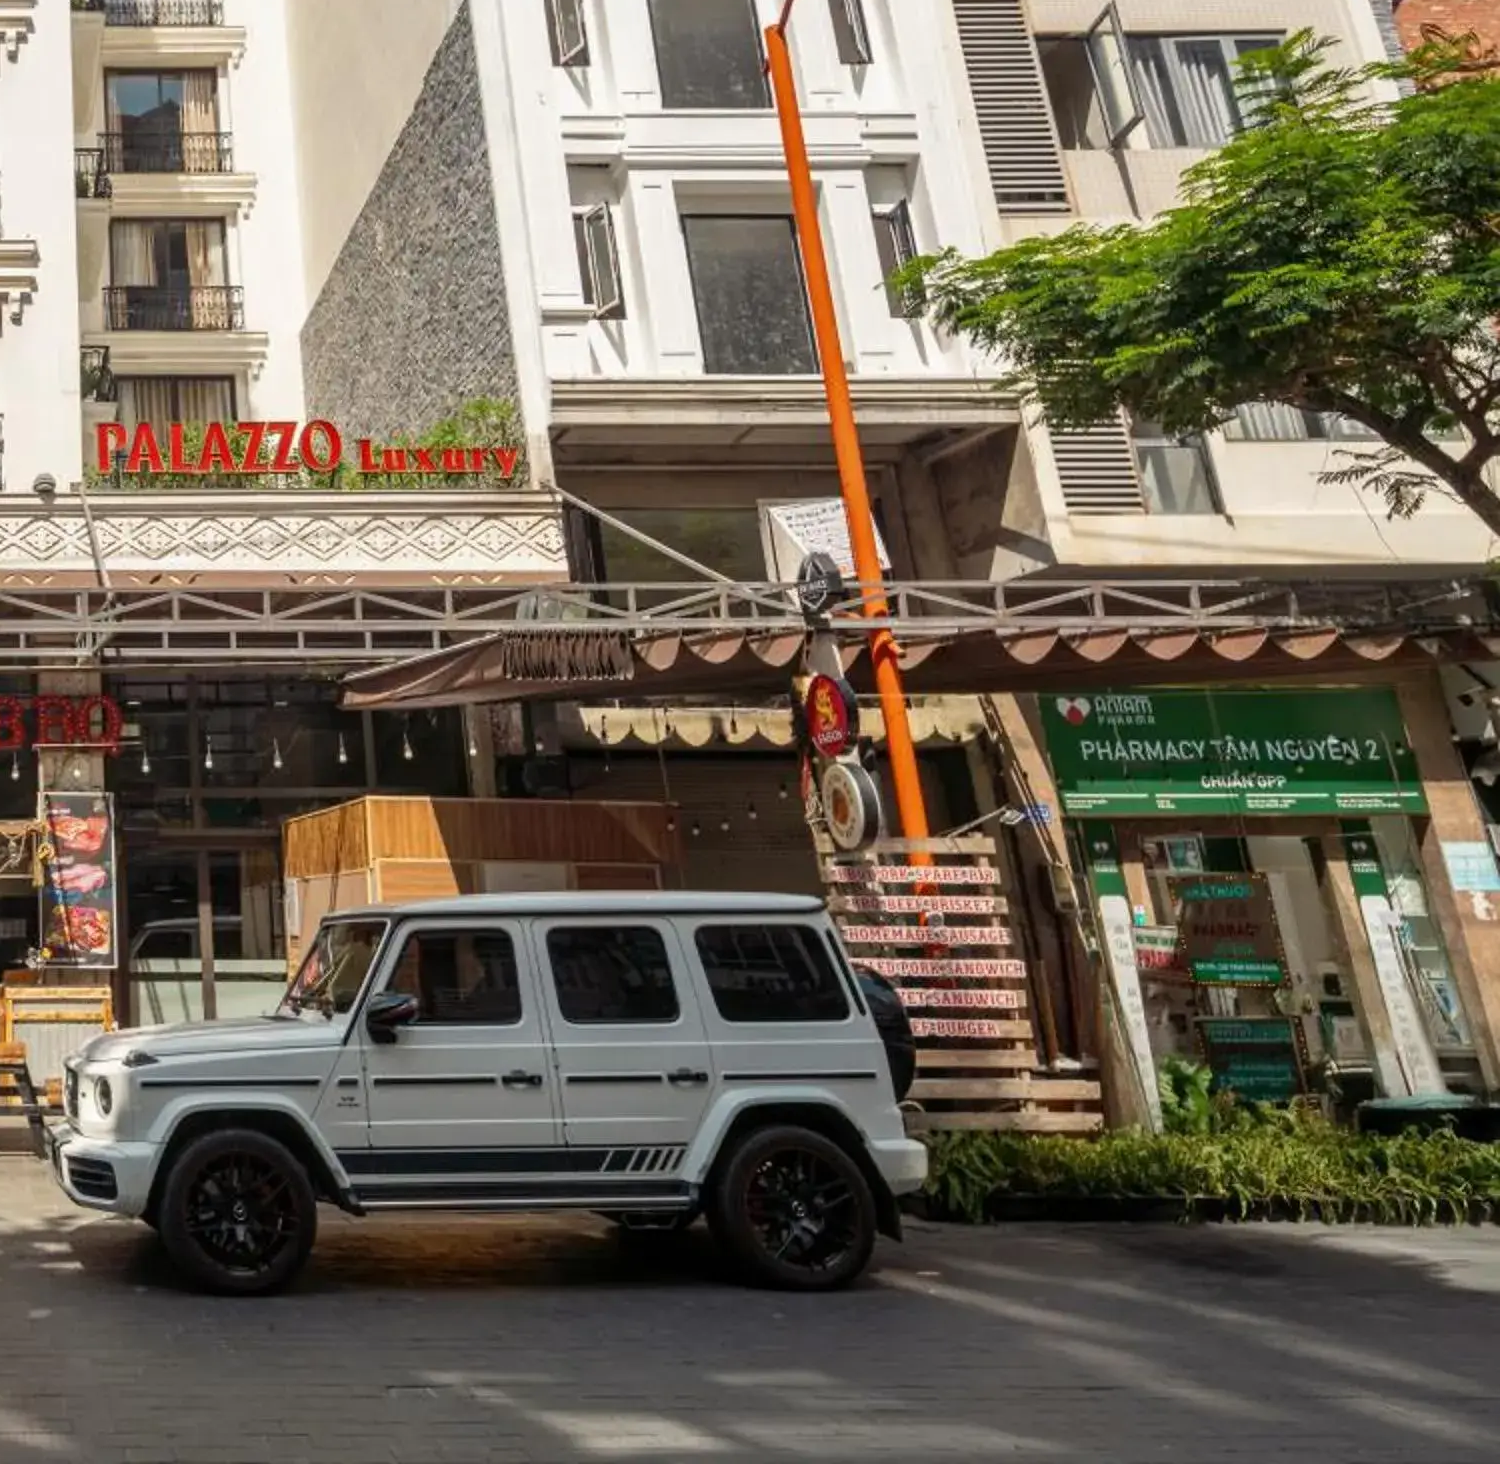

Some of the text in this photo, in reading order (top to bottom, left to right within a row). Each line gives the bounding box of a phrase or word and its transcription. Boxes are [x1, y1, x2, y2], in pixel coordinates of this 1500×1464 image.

[94, 419, 519, 479] PALAZZO Luxury
[1080, 739, 1205, 761] PHARMACY
[1364, 739, 1382, 761] 2
[1255, 775, 1288, 789] GPP
[916, 867, 963, 882] SPARE
[931, 897, 994, 911] BRISKET
[849, 926, 1011, 944] HOMEMADE SAUSAGE
[901, 960, 941, 976] PORK
[948, 960, 1024, 977] SANDWICH
[933, 990, 1015, 1006] SANDWICH
[937, 1021, 997, 1036] BURGER
